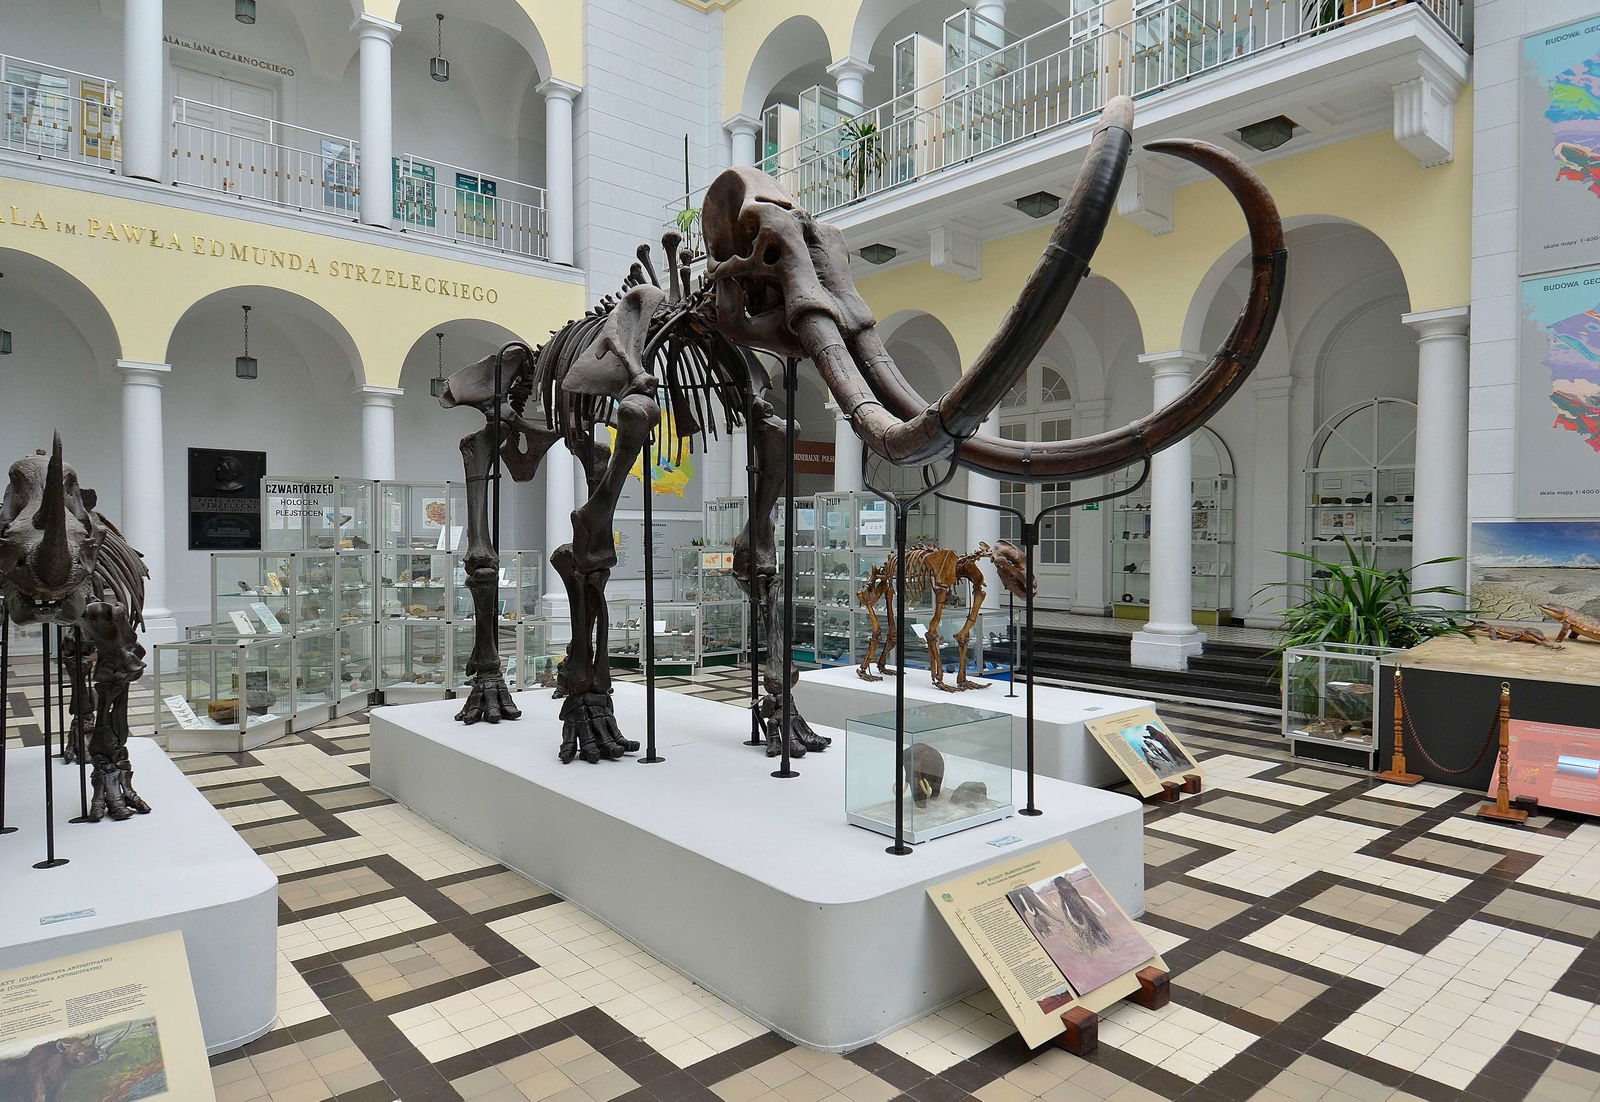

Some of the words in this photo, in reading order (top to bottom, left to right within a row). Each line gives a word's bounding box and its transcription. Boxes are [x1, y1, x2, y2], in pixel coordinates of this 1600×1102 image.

[1545, 30, 1580, 45] BUDOWA
[192, 42, 217, 56] JANA
[219, 49, 295, 77] CZARNOCKIEGO
[87, 218, 183, 252] PAWŁA
[192, 235, 319, 275] EDMUNDA
[329, 260, 499, 305] STRZELECKIEGO
[1543, 281, 1579, 292] BUDOWA
[794, 453, 820, 462] MINERALNE
[266, 484, 334, 496] CZWARTORZĘD
[275, 509, 324, 517] PLEJSTOCEN
